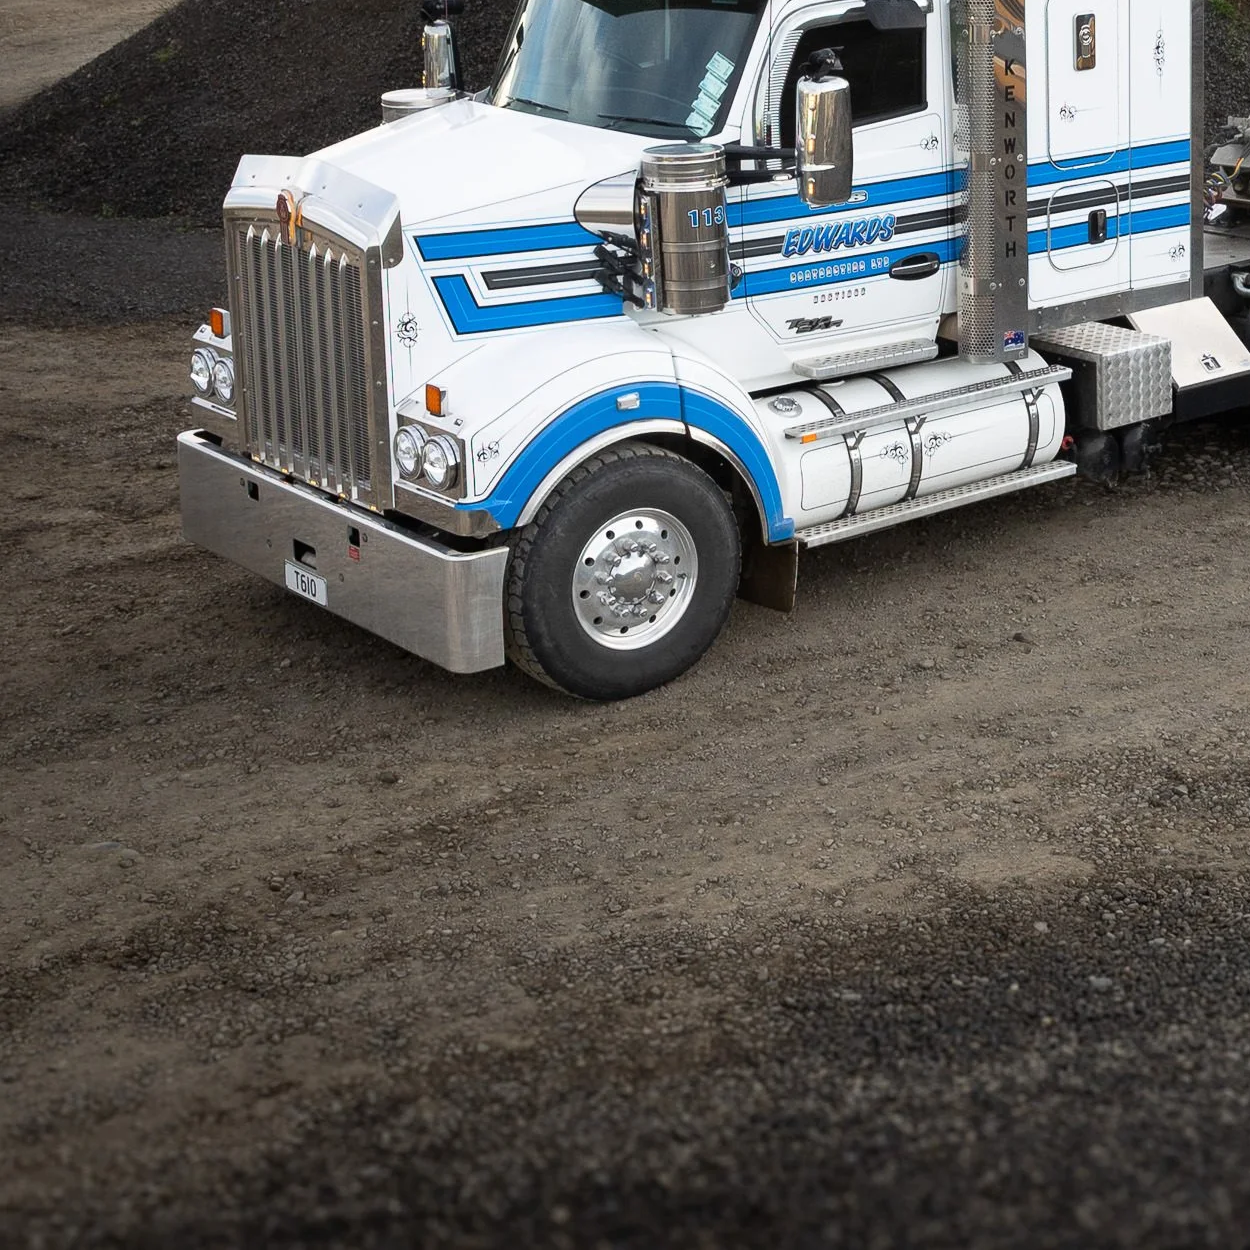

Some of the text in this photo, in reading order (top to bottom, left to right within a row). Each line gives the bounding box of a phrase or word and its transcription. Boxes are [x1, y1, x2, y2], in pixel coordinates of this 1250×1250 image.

[1003, 58, 1018, 259] KENWORTH
[687, 205, 724, 228] 113
[781, 213, 897, 257] EDWARDS
